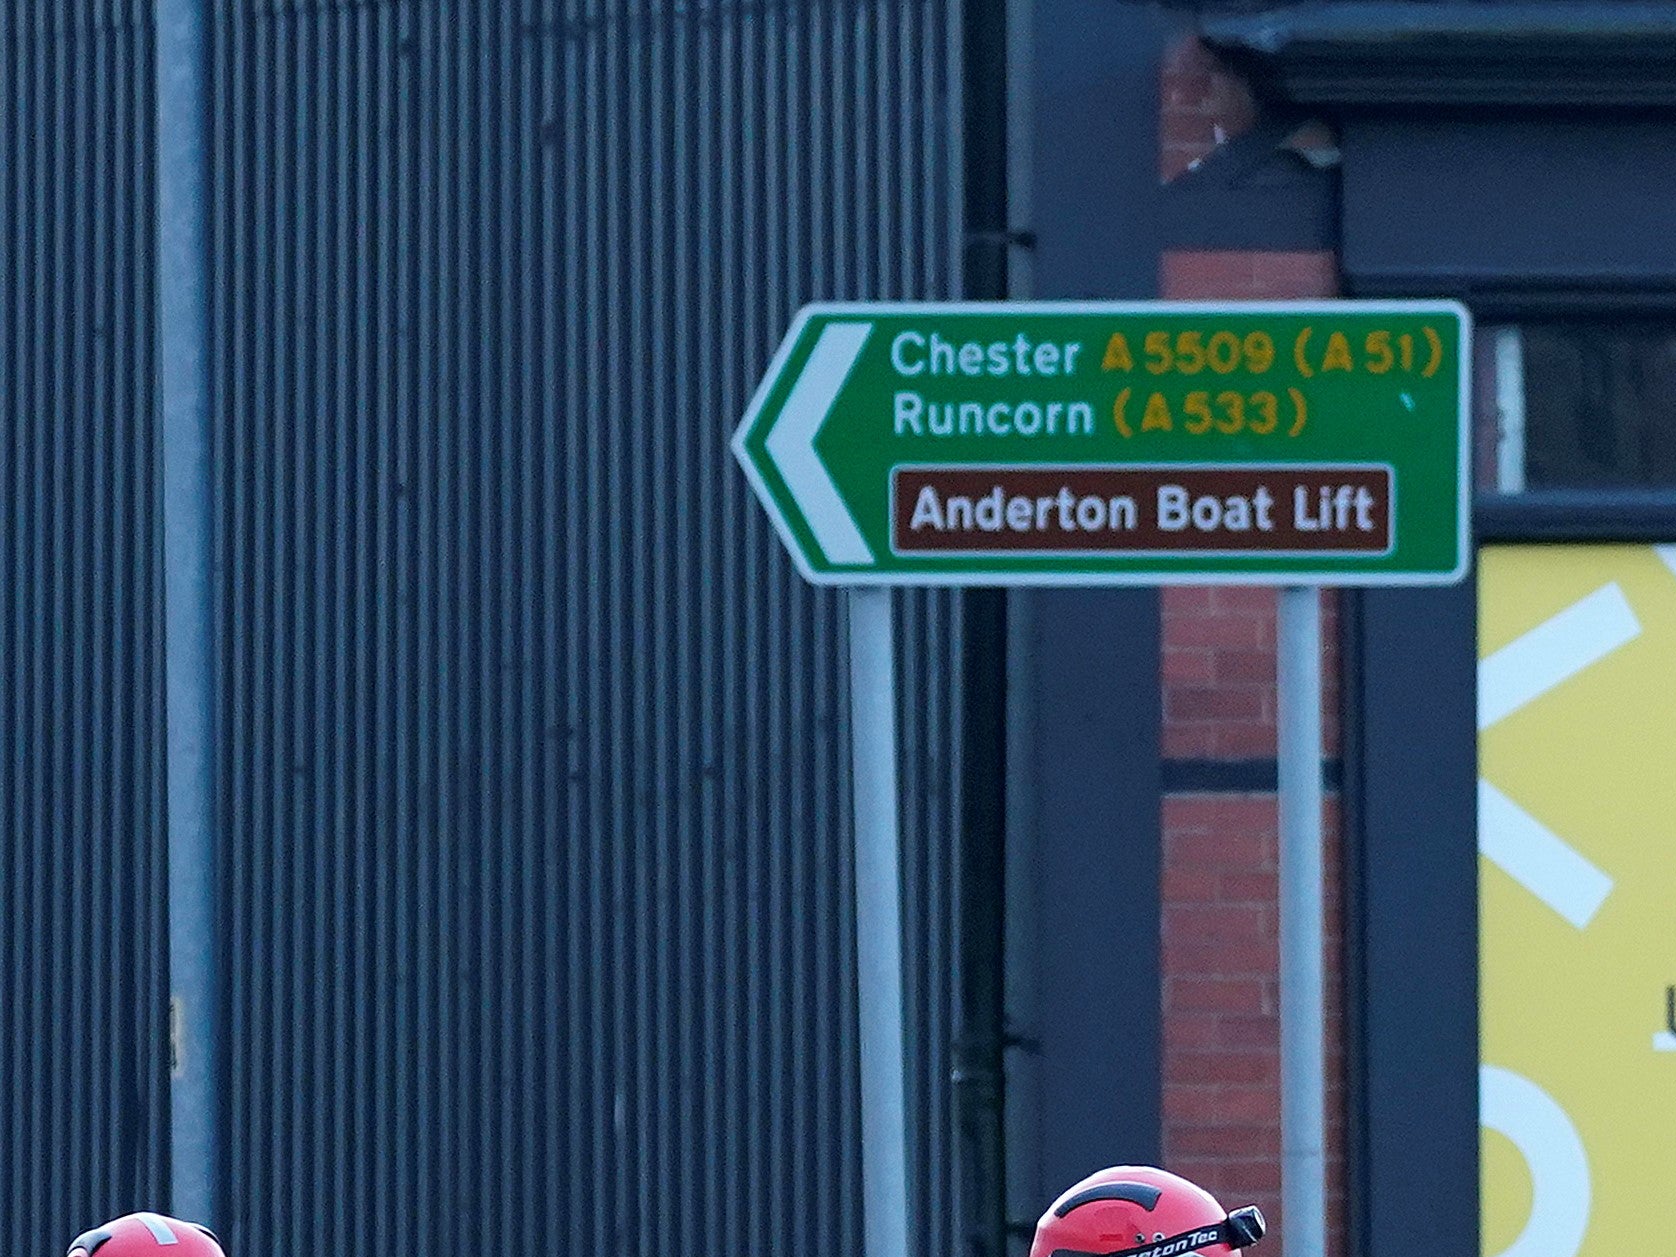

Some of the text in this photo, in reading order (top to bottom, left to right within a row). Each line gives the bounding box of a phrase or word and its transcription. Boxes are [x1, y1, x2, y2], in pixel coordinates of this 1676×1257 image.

[892, 332, 1080, 376] Chester
[894, 392, 1092, 436] Runcorn
[910, 486, 1374, 532] Anderton Boat Lift
